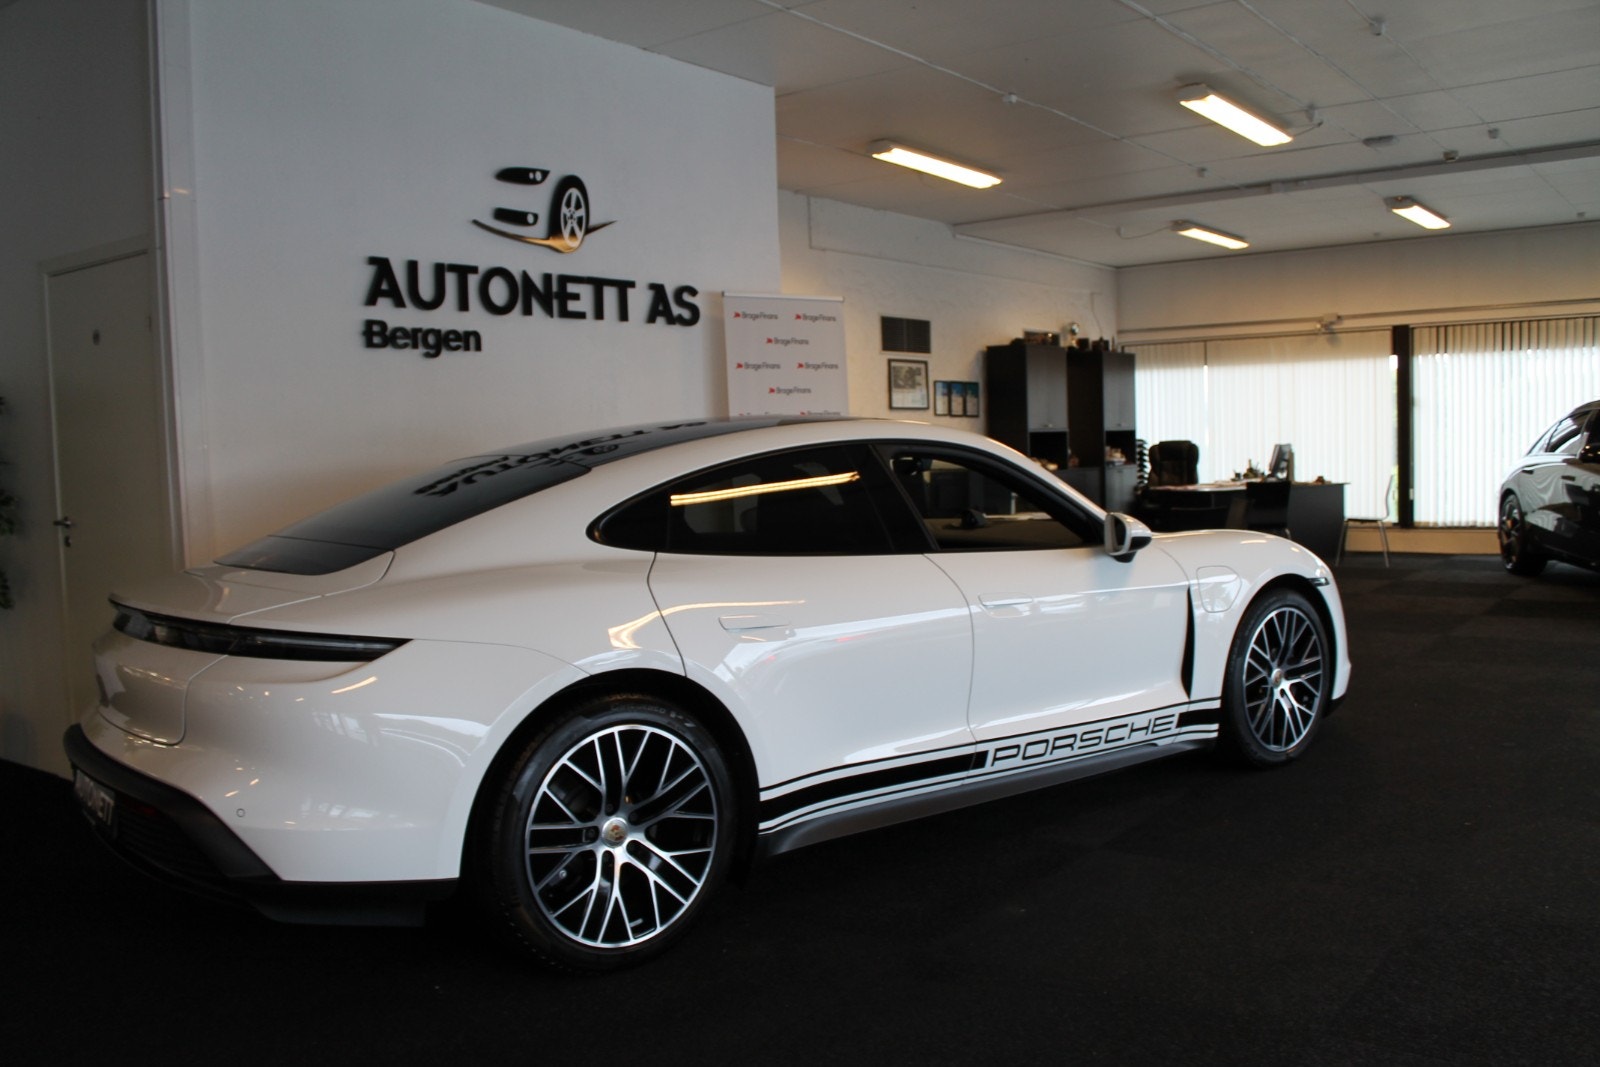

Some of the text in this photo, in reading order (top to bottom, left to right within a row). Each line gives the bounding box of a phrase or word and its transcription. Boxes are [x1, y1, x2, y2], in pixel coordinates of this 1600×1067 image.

[364, 256, 701, 327] AUTONETT AS
[362, 319, 482, 358] Bergen
[991, 714, 1175, 767] PORSCHE
